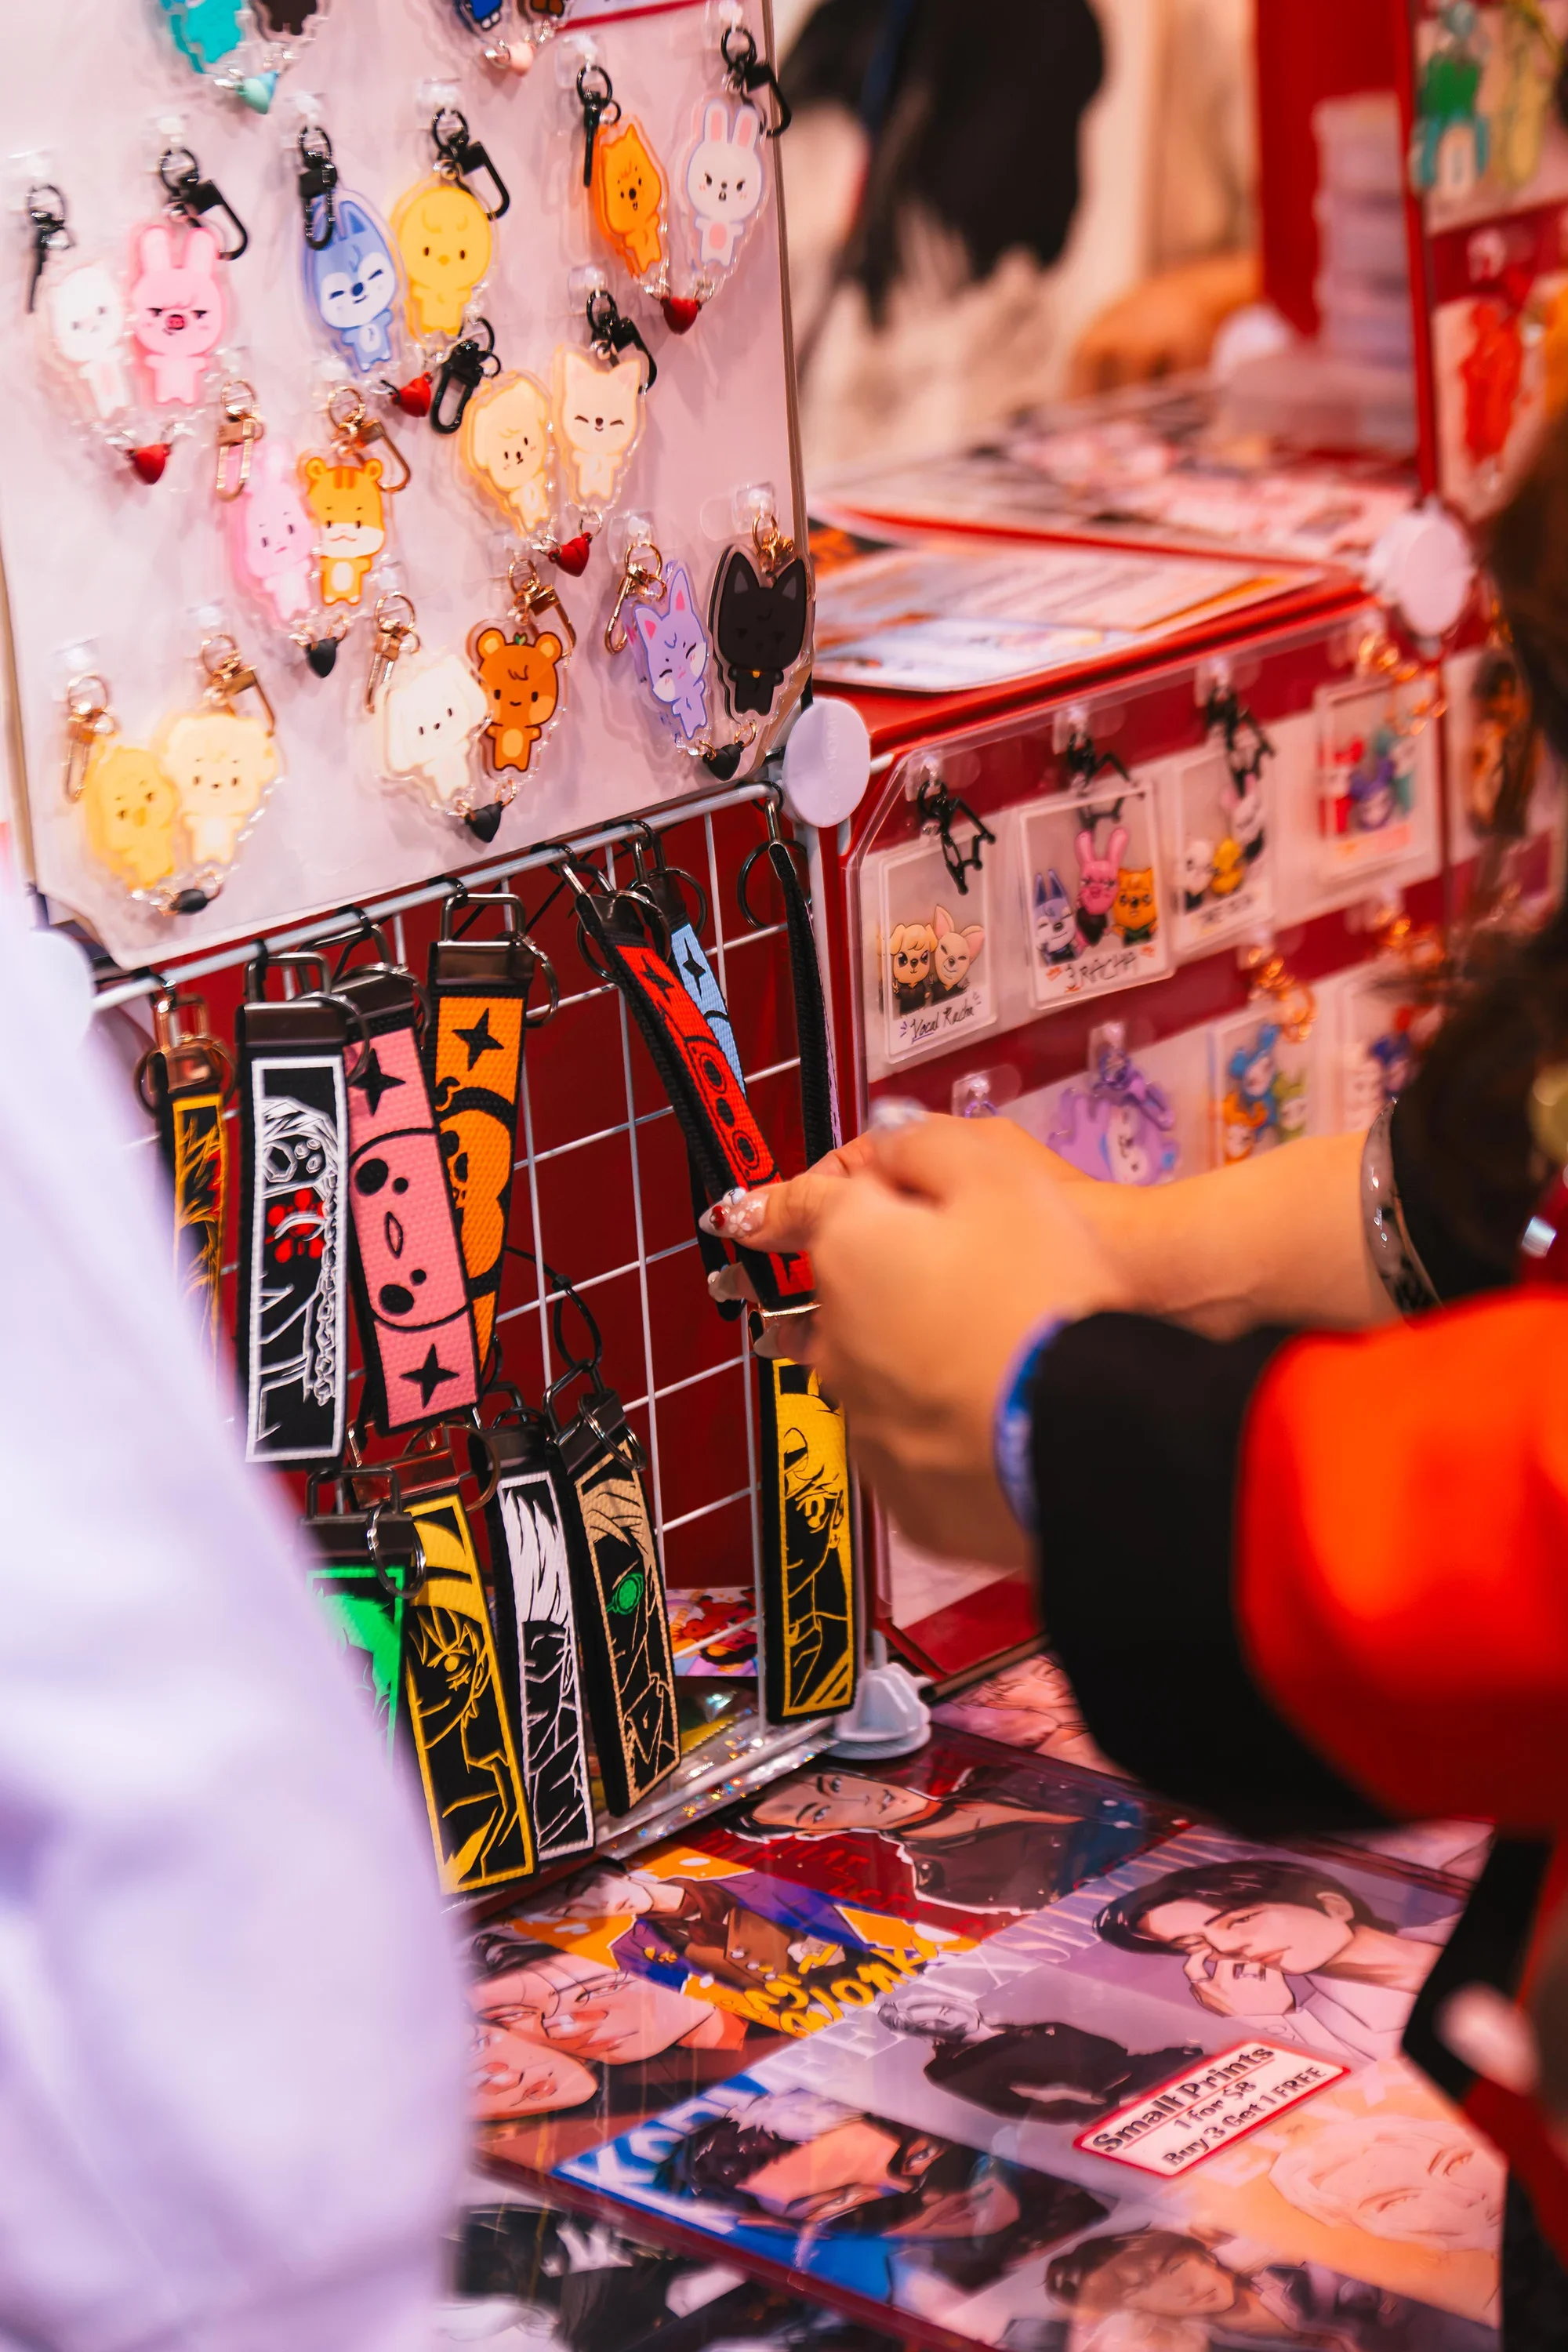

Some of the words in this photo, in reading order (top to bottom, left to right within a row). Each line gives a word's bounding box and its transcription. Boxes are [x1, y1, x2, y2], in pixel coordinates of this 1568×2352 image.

[1092, 2092, 1183, 2153] Small
[1175, 2047, 1274, 2100] Prints
[1162, 2138, 1209, 2167] Buy
[1203, 2126, 1226, 2140] 3
[1221, 2103, 1266, 2128] Get
[1260, 2094, 1278, 2107] 1
[1271, 2067, 1328, 2099] FREE
[1174, 2119, 1192, 2131] 1
[1187, 2099, 1225, 2124] for
